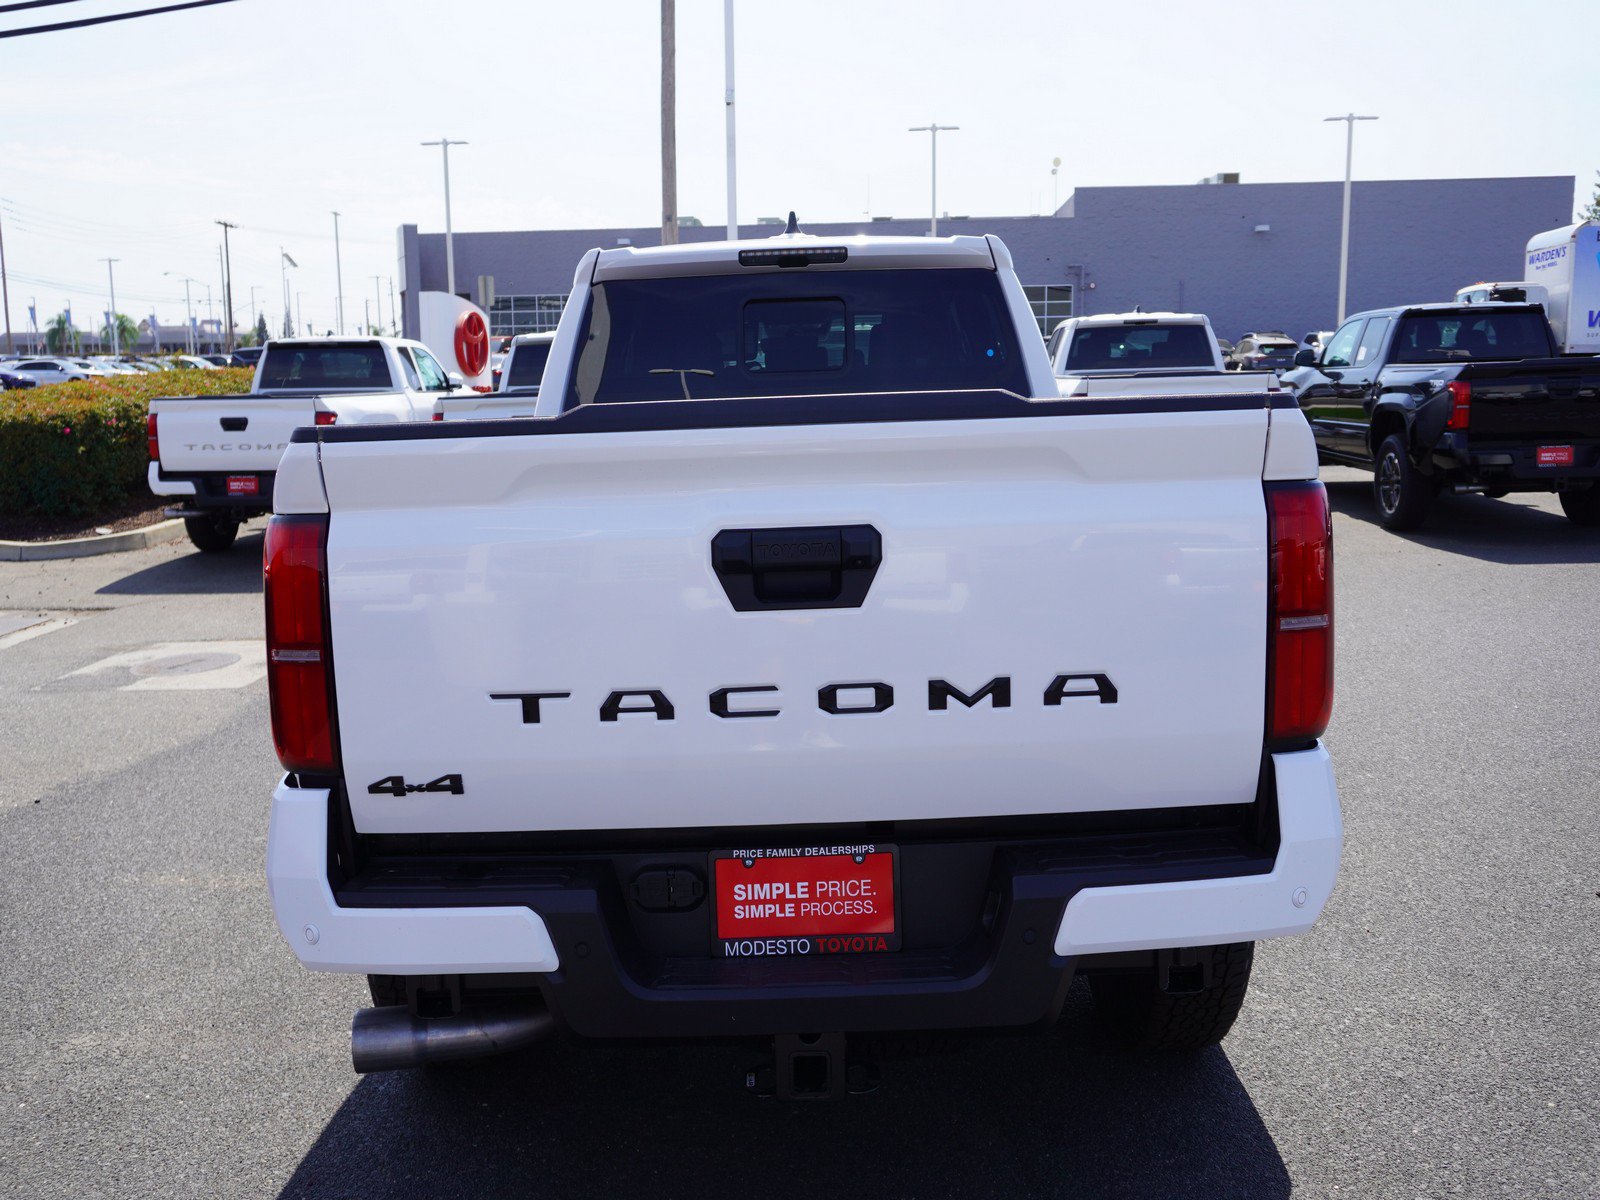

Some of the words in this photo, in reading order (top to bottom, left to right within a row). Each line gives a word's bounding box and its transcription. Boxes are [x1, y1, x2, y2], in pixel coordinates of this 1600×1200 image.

[1528, 246, 1567, 265] WARDEN'S
[756, 542, 838, 561] TOYOTA
[489, 672, 1119, 725] TACOMA
[733, 849, 763, 858] PRICE
[766, 848, 802, 857] FAMILY
[805, 844, 875, 856] DEALERSHIPS
[733, 882, 809, 901] SIMPLE
[816, 879, 877, 898] PRICE.
[734, 903, 796, 919] SIMPLE
[800, 900, 877, 917] PROCESS.
[725, 938, 810, 957] MODESTO
[816, 936, 888, 953] TOYOTA
